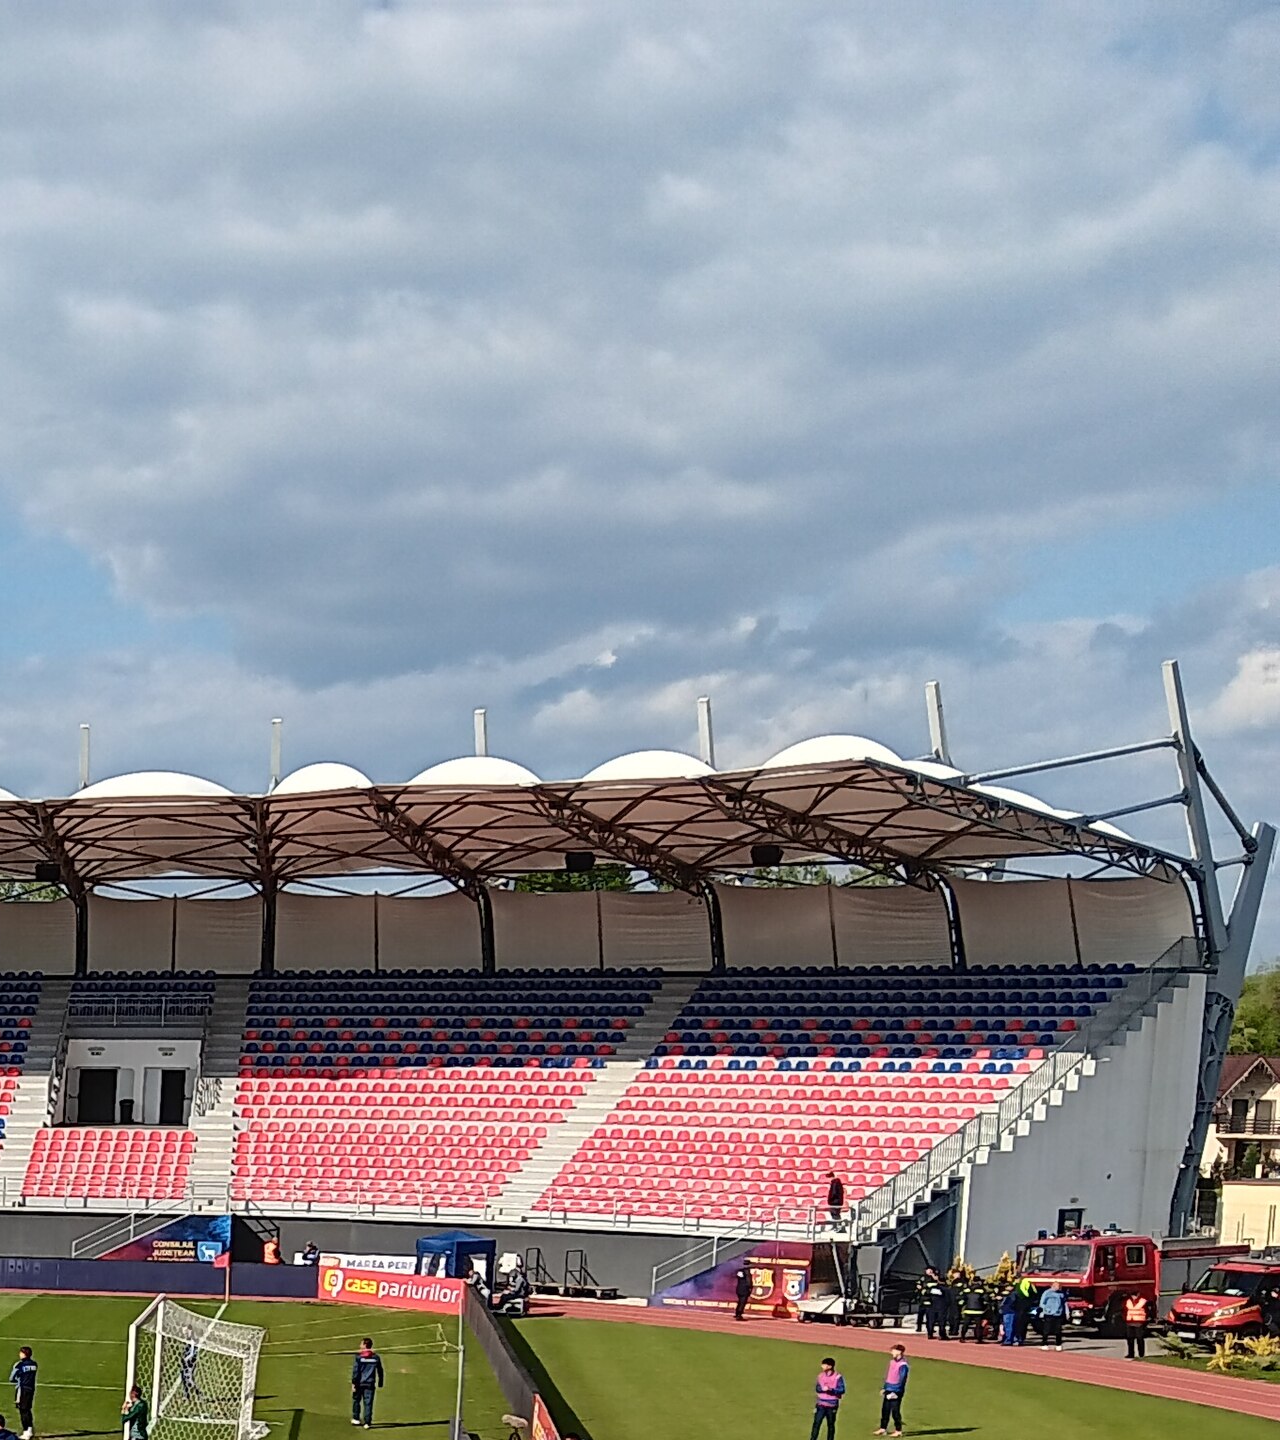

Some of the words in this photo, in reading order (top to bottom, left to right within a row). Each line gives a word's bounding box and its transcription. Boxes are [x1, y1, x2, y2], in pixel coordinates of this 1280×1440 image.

[346, 1259, 385, 1269] MAREA
[344, 1277, 378, 1294] casa
[378, 1281, 460, 1304] pariurilor
